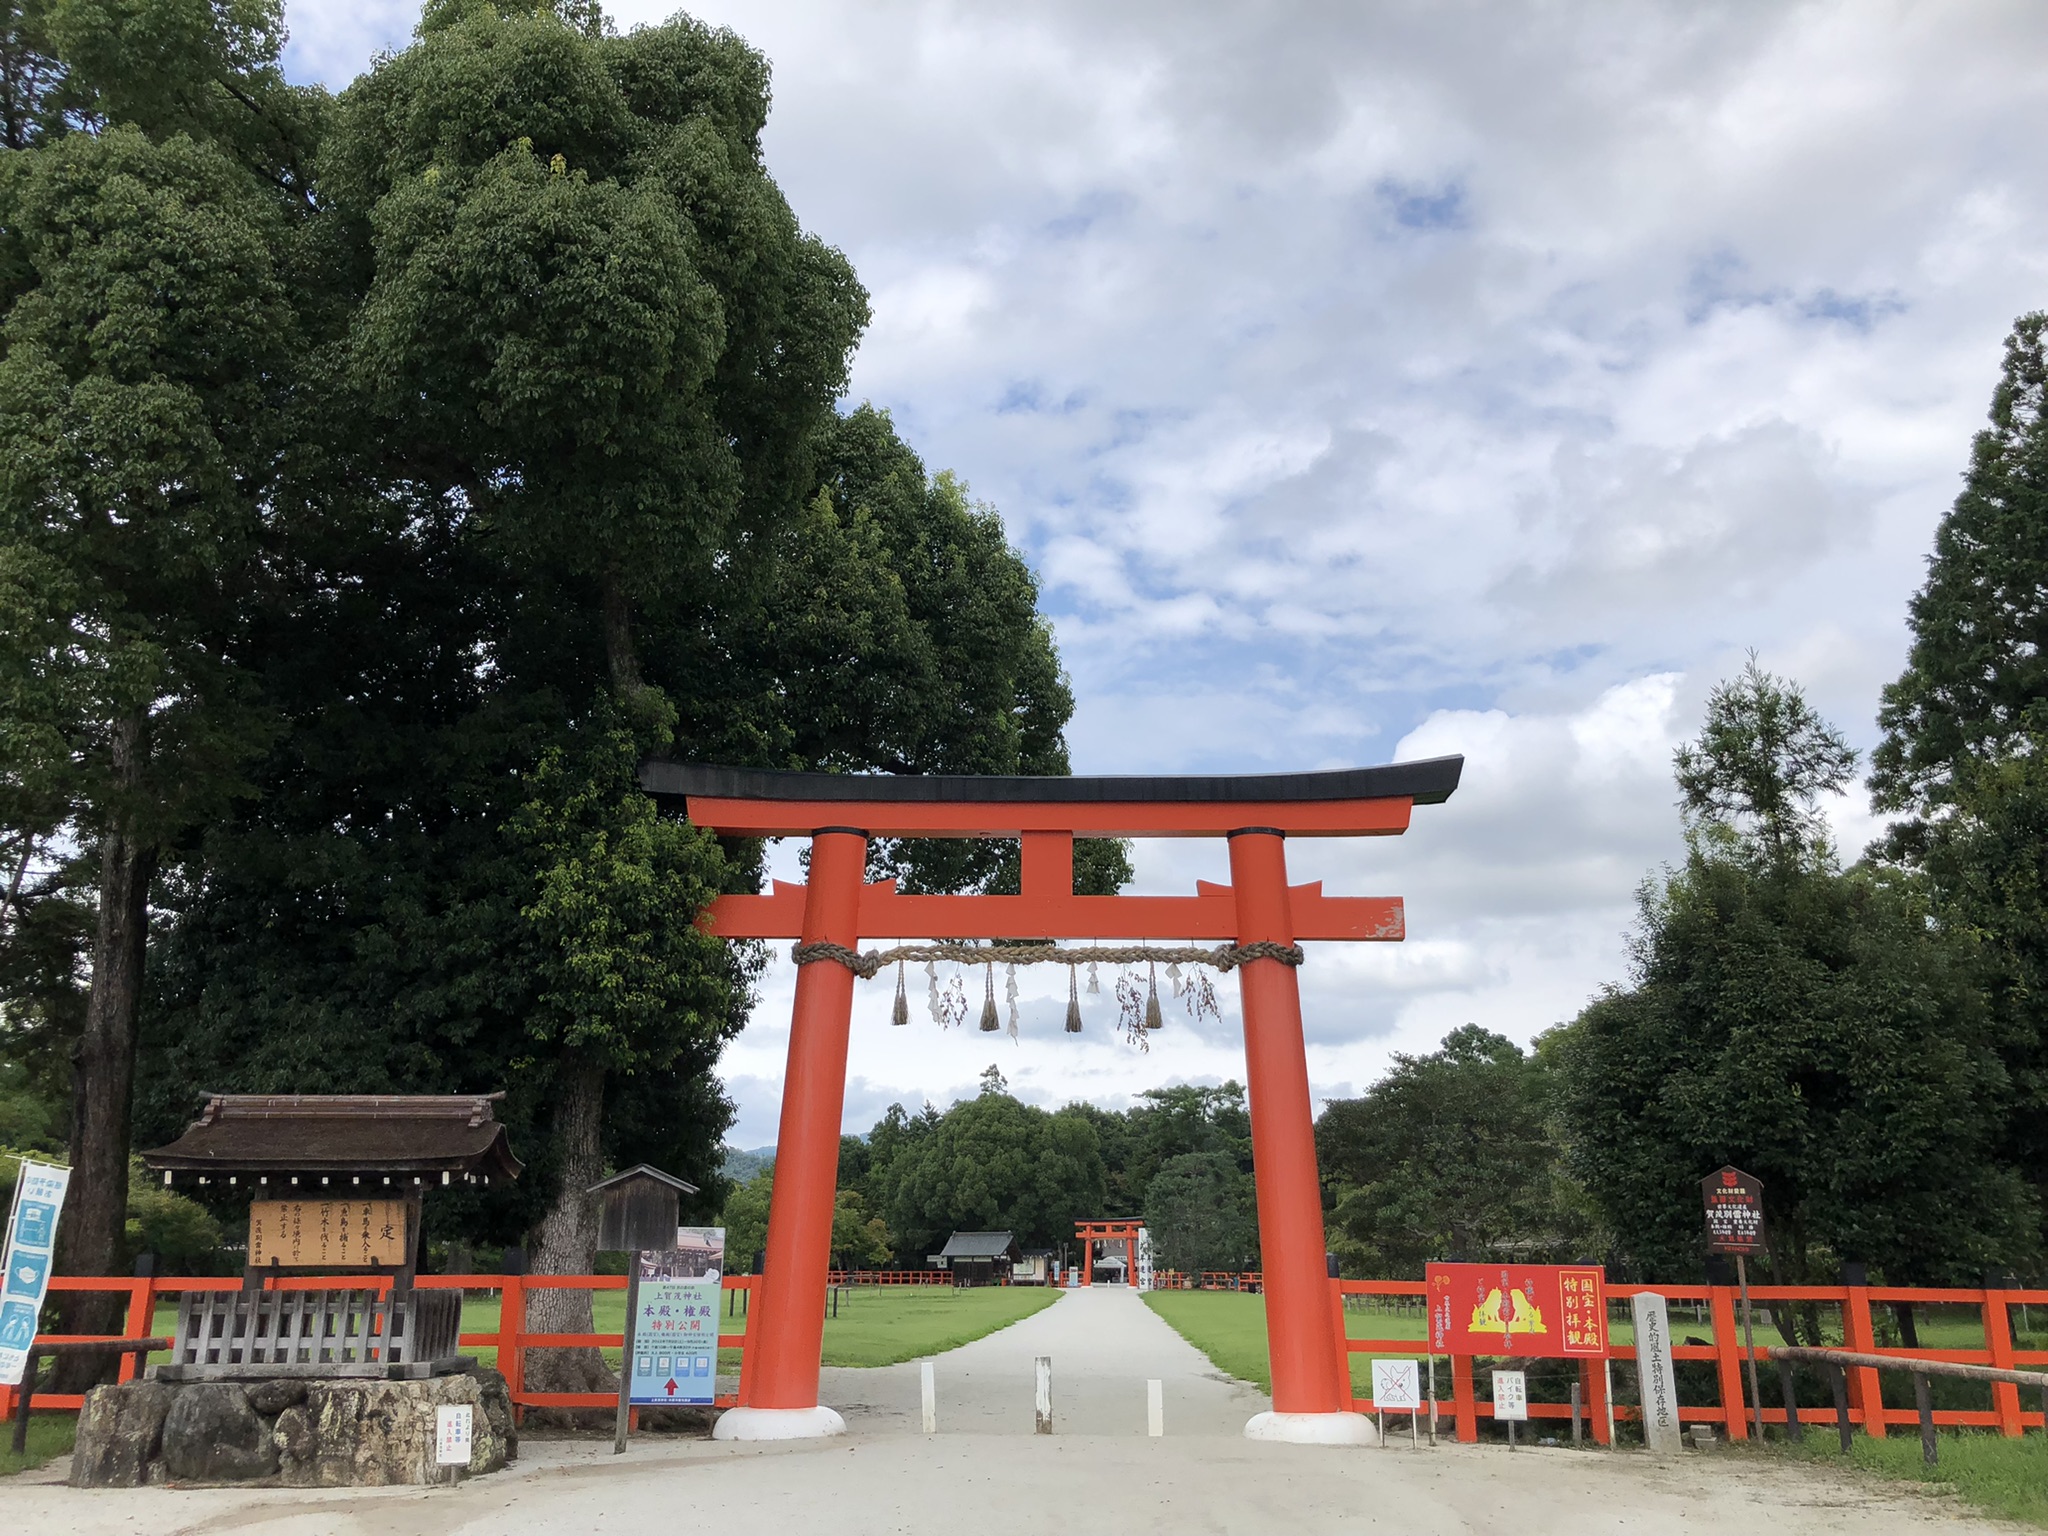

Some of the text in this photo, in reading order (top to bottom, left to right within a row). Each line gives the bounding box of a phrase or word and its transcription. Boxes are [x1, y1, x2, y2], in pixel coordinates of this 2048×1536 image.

[1706, 1209, 1761, 1219] 賀茂別雷神社
[379, 1225, 396, 1240] 定
[654, 1292, 703, 1301] 上賀茂神社
[643, 1304, 712, 1318] 本殿・権殿
[1563, 1277, 1583, 1346] 特別拝観
[1581, 1278, 1600, 1347] 国宝・本殿
[651, 1319, 701, 1331] 特別公開
[1645, 1310, 1669, 1427] 歴史的風土特別保存地区
[1497, 1377, 1505, 1410] 進入禁止
[1506, 1377, 1515, 1410] バイク等
